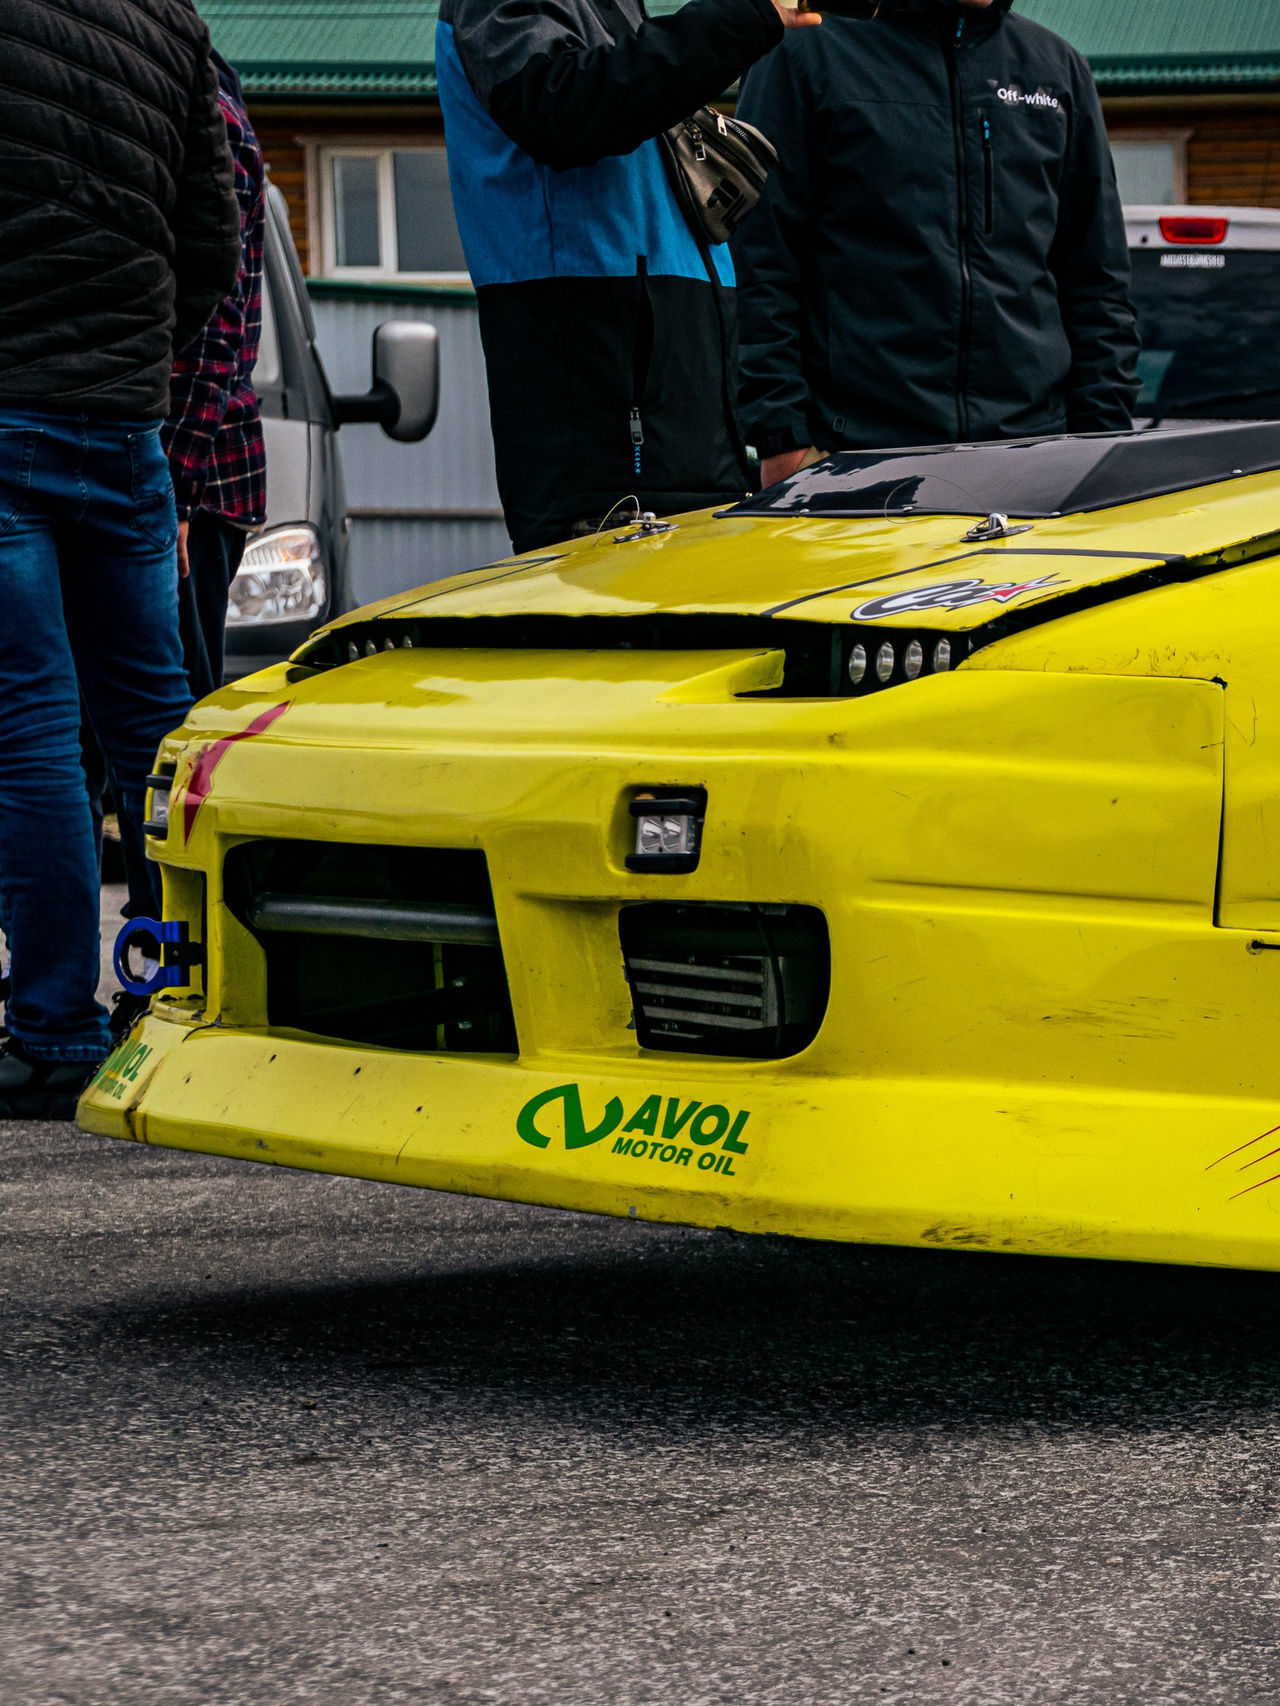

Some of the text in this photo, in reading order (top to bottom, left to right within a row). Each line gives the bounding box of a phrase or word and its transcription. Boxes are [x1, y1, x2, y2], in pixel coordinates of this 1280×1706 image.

[996, 87, 1059, 109] Off-white
[621, 1094, 751, 1155] AVOL
[611, 1136, 737, 1177] MOTOR OIL
